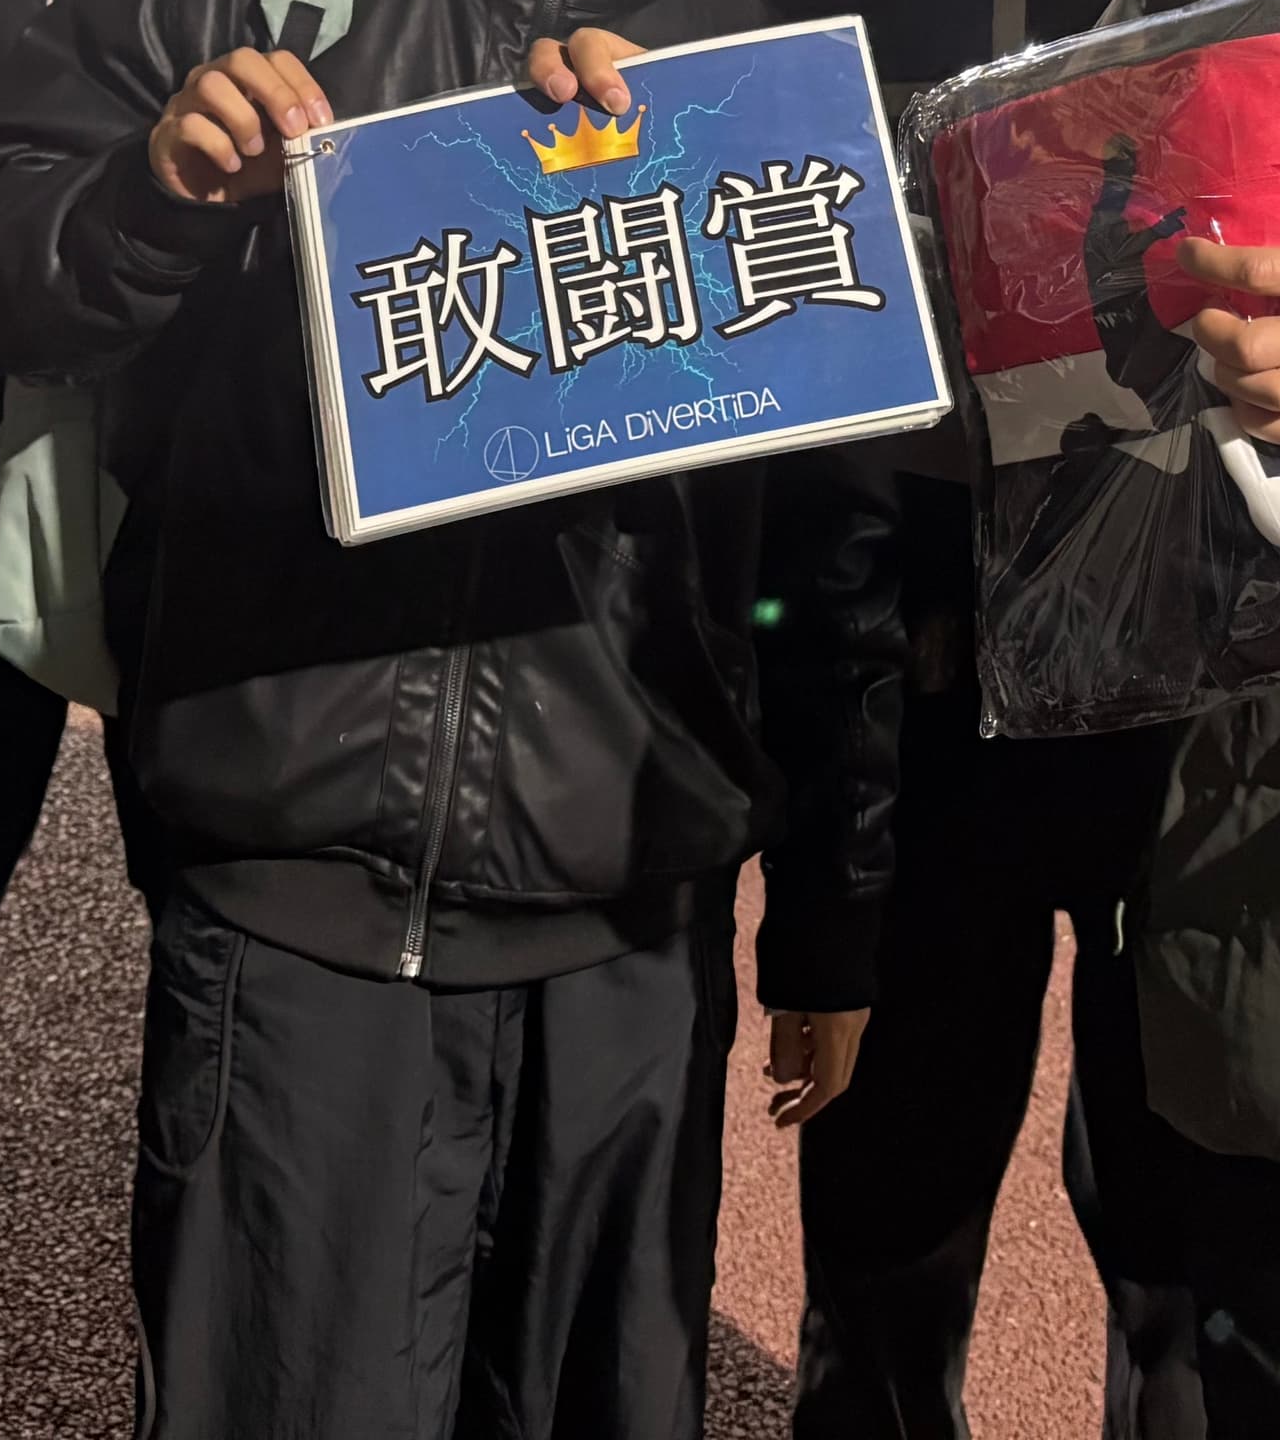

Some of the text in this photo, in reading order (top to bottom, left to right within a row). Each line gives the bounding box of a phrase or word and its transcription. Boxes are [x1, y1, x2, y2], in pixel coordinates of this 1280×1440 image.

[354, 157, 884, 400] 敢闘賞
[544, 419, 618, 458] LiGA
